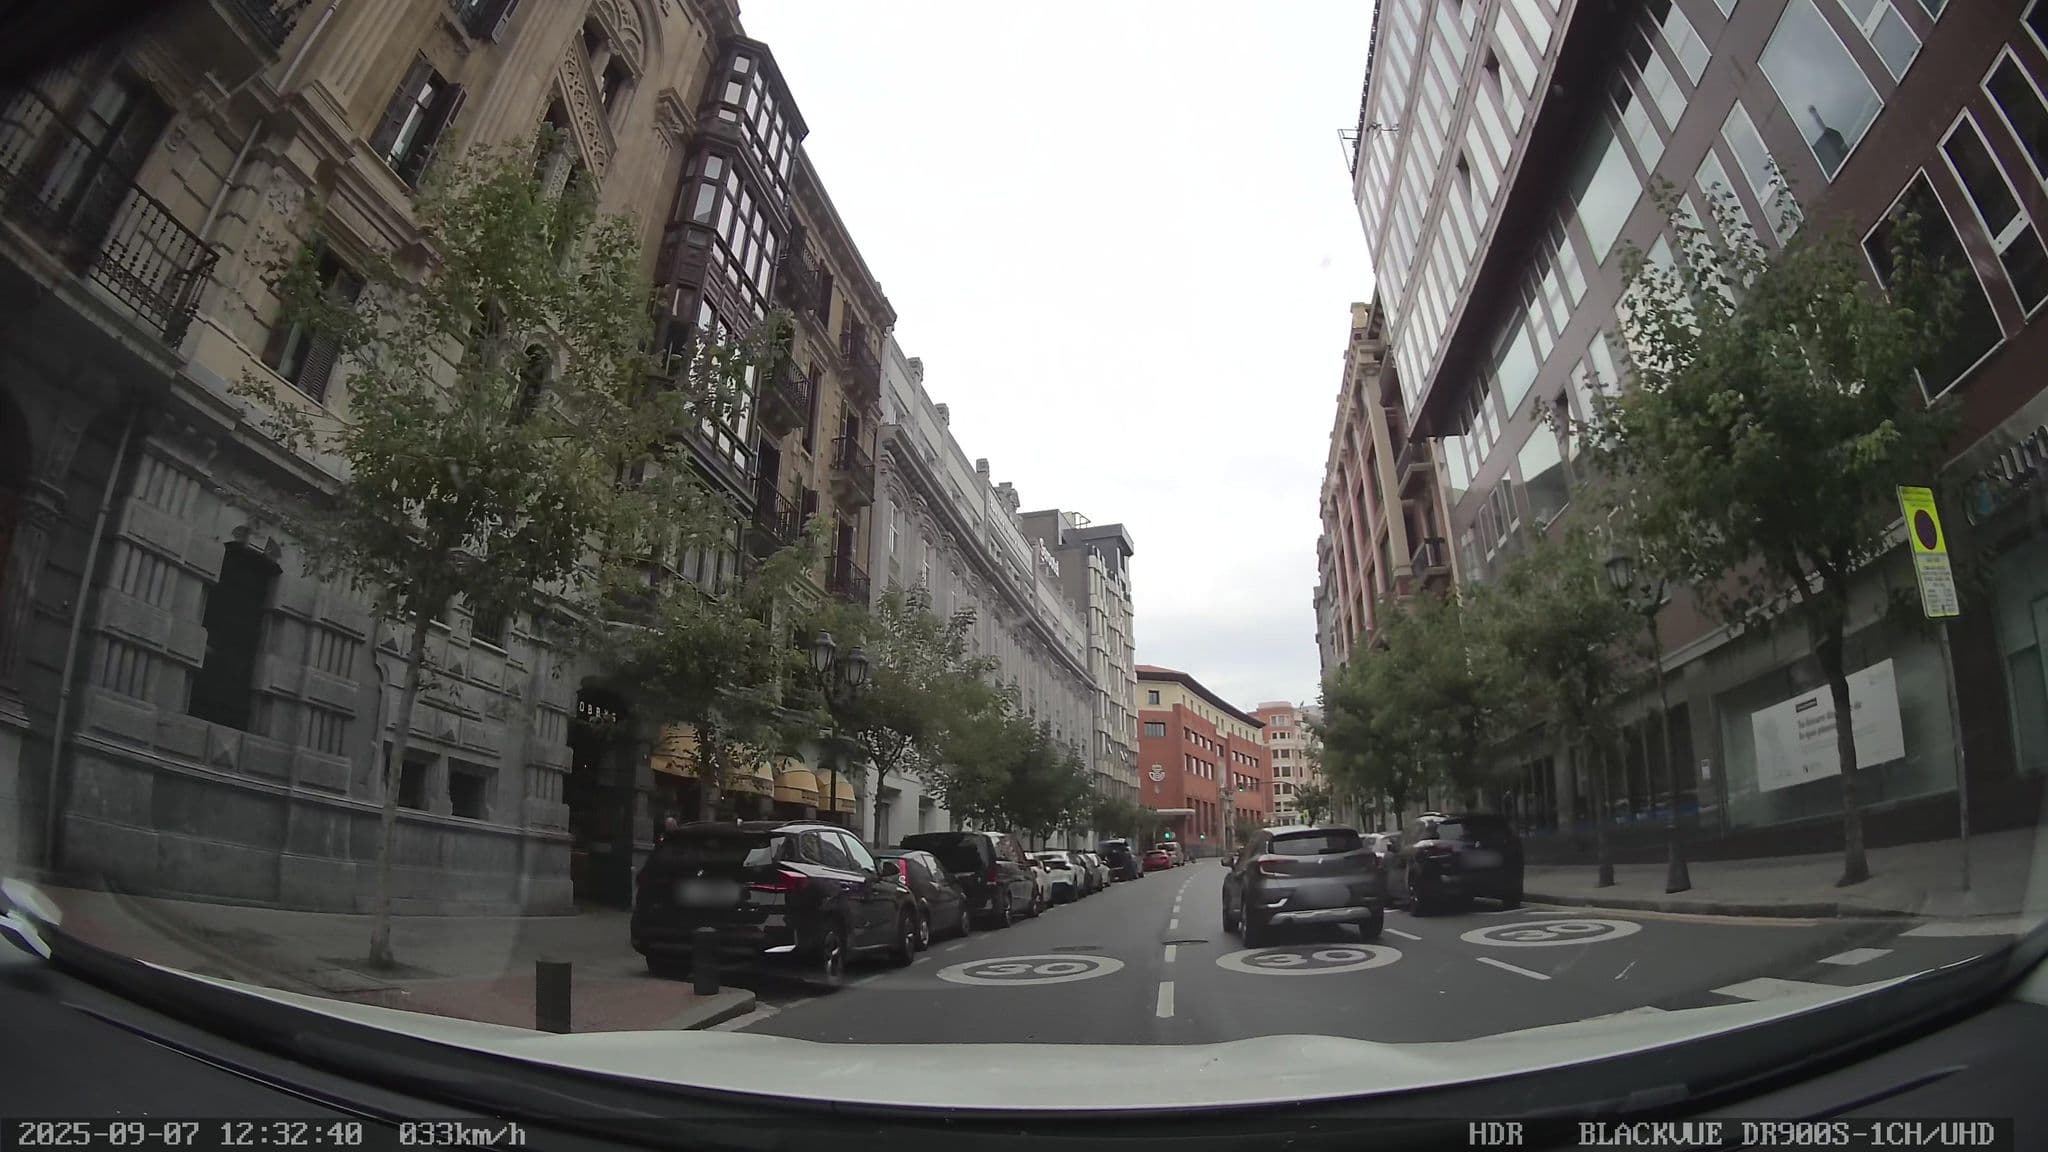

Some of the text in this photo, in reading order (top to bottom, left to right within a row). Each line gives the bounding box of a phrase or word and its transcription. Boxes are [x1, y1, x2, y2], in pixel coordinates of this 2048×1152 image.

[1500, 922, 1606, 940] 30
[1253, 950, 1368, 967] 30
[975, 962, 1089, 976] 30
